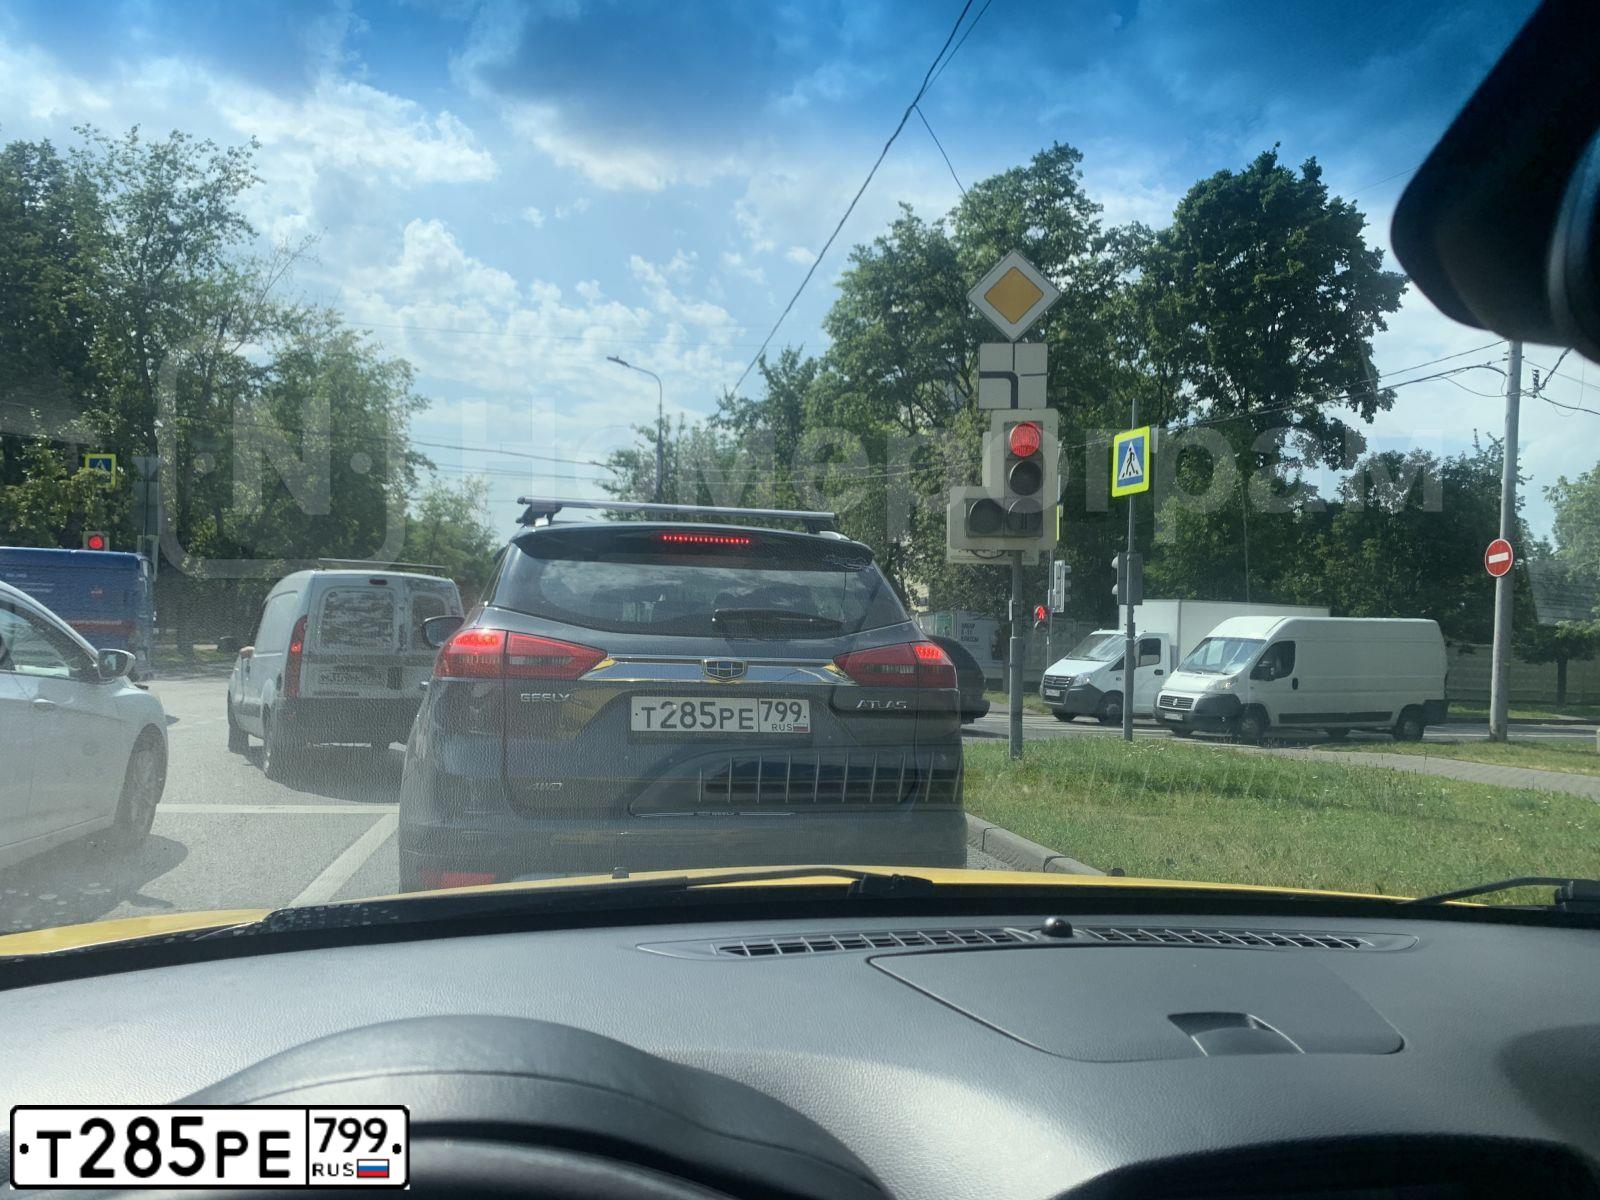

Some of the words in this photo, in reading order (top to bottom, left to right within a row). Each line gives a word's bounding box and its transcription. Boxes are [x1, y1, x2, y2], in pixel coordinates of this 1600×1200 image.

[520, 692, 571, 703] GEELY
[856, 699, 907, 709] ATLAS
[641, 701, 754, 730] Т285РЕ
[760, 700, 802, 722] 799
[771, 723, 793, 732] RUS
